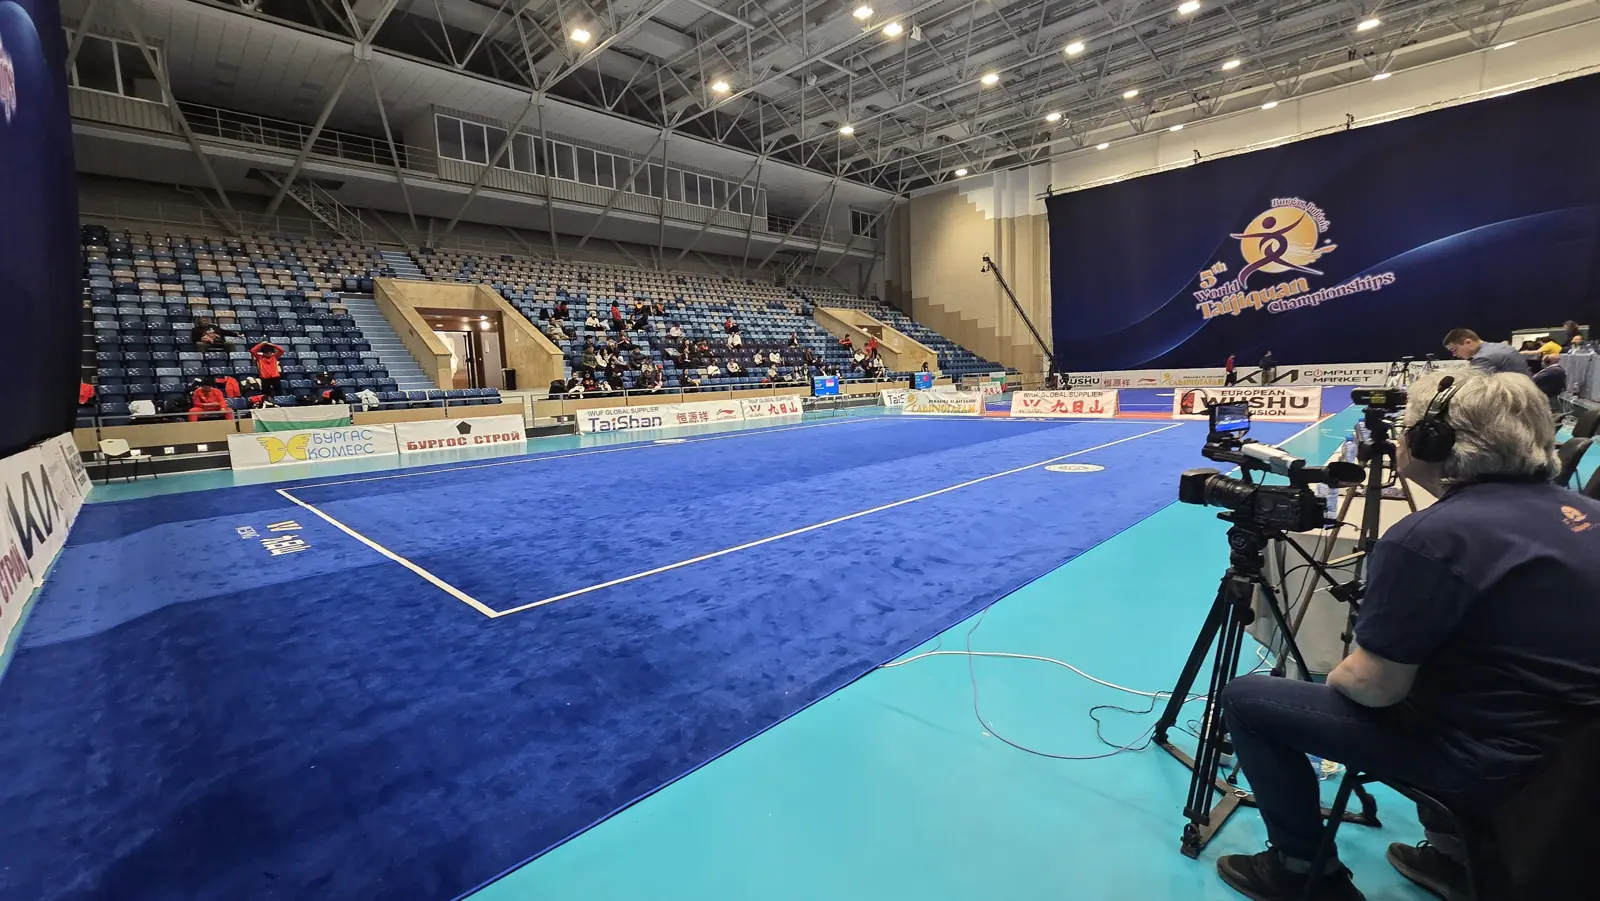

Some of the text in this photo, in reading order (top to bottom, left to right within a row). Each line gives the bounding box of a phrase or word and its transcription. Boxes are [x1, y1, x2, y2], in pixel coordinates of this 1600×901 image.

[1305, 202, 1331, 233] Bulgaria
[1199, 261, 1228, 290] 5th
[1193, 280, 1241, 303] World
[1196, 276, 1309, 320] Taijiquan
[1267, 271, 1396, 314] Championships
[1303, 368, 1385, 378] COMPUTER
[1069, 391, 1104, 399] SUPPLIER
[1221, 389, 1287, 397] EUROPEAN
[605, 408, 630, 416] GLOBAL
[631, 406, 659, 414] SUPPLIER
[768, 401, 797, 415] 九日山
[1051, 399, 1104, 414] 九日山
[588, 415, 662, 432] TaiShan
[676, 411, 710, 424] 恒源祥
[313, 429, 373, 445] БУРГАС
[407, 431, 520, 451] БУРГОС СТРОЙ
[308, 444, 375, 460] КОМЕРС
